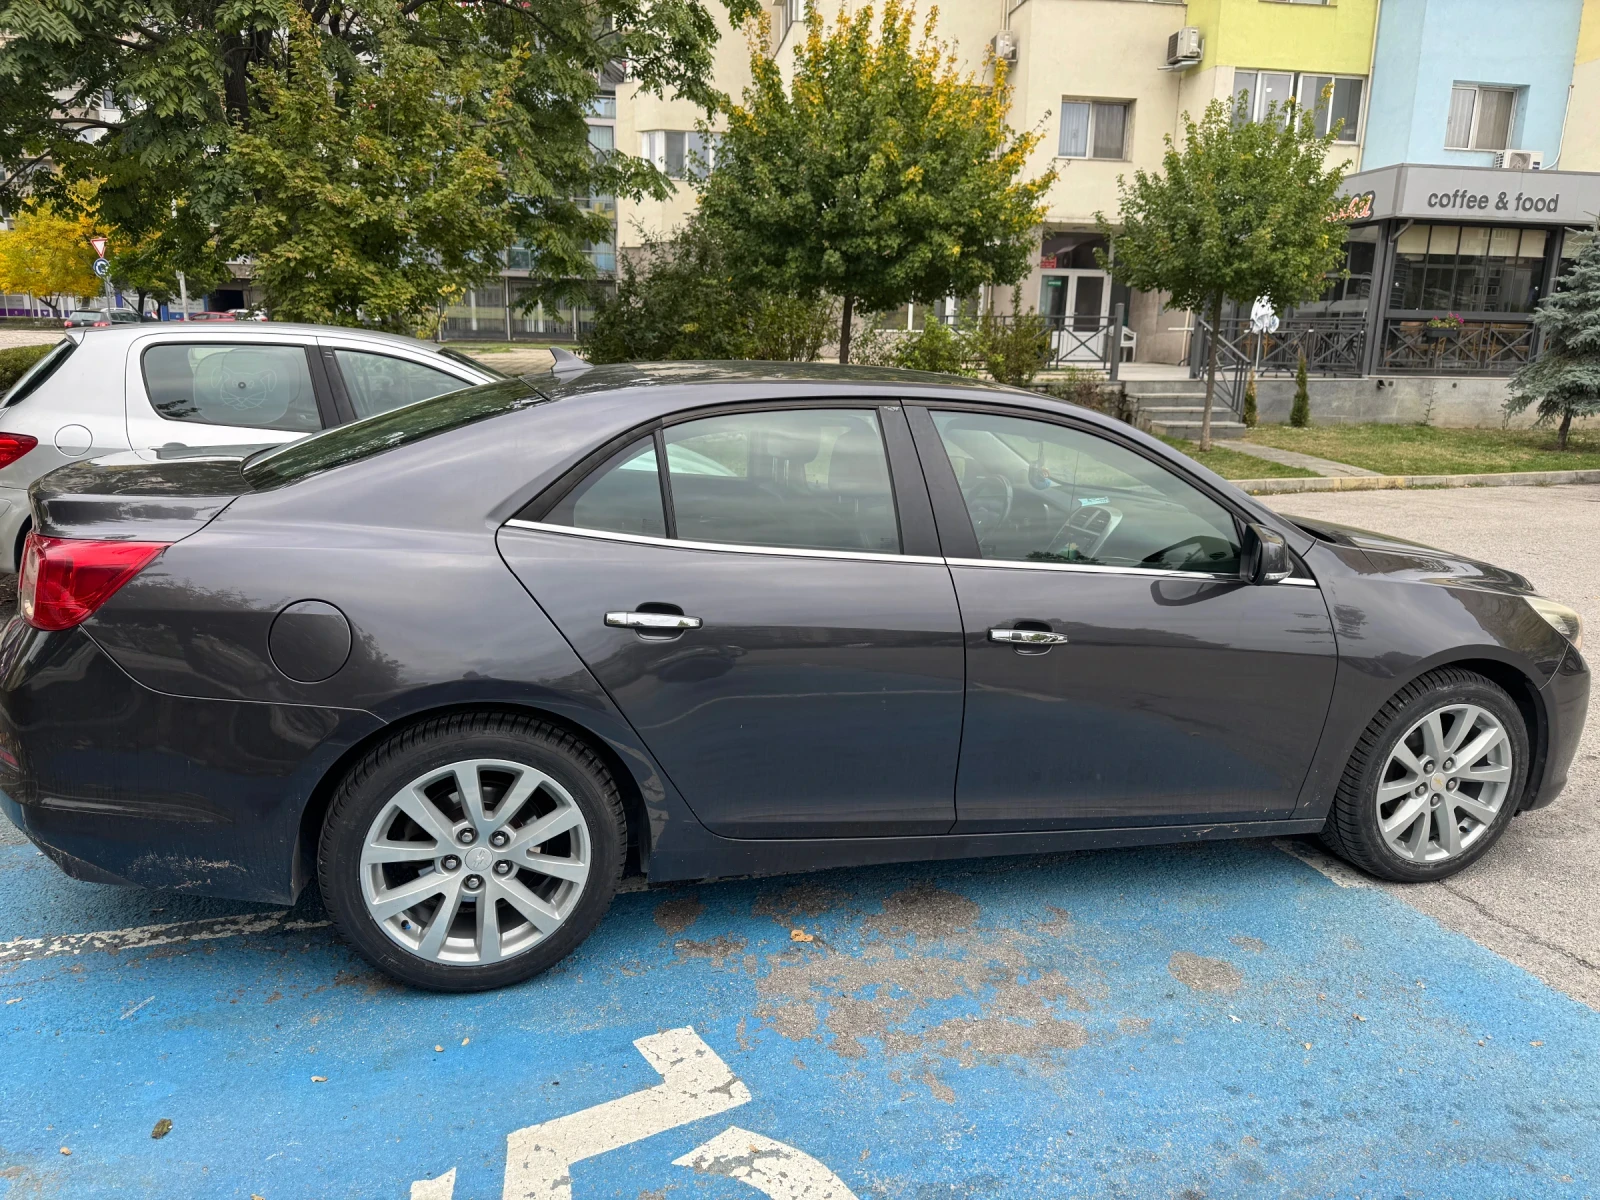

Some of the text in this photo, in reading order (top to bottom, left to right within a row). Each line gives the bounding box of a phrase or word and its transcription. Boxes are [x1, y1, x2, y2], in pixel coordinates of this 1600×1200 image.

[1427, 189, 1560, 212] coffee & food
